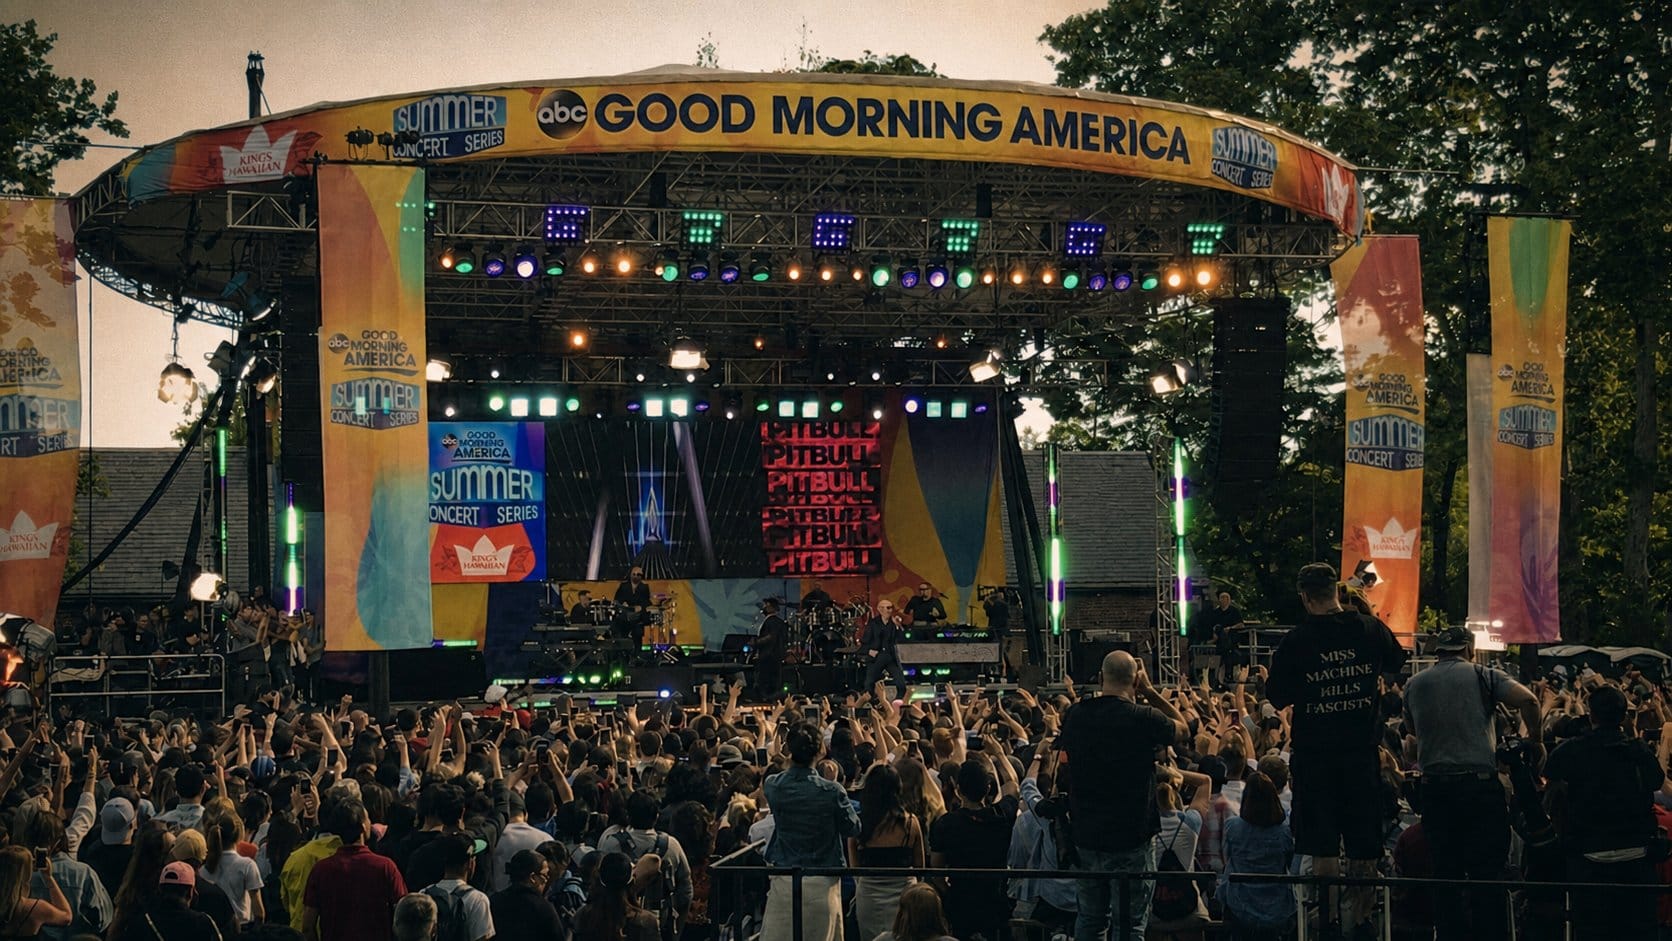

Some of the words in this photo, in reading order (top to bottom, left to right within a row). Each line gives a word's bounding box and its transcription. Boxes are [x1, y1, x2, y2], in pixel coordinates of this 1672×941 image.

[398, 95, 498, 132] SUMMER
[537, 101, 588, 124] abc
[595, 93, 755, 133] GOOD
[772, 95, 1003, 142] MORNING
[1009, 106, 1191, 165] AMERICA
[465, 130, 504, 153] SERIES
[1216, 128, 1275, 171] SUMMER
[1212, 159, 1246, 186] CONCERT
[328, 335, 350, 348] abc
[361, 330, 398, 340] GOOD
[350, 340, 408, 353] MORNING
[0, 356, 50, 368] ORNING
[343, 352, 416, 367] AMERICA
[0, 367, 62, 383] MERICA
[335, 379, 414, 409] SUMMER
[1511, 380, 1555, 396] AMERICA
[1366, 390, 1419, 407] AMERICA
[331, 409, 376, 428] CONCERT
[389, 411, 418, 427] SERIES
[1504, 405, 1552, 431] SUMMER
[467, 431, 496, 439] GOOD
[1353, 416, 1425, 452] SUMMER
[453, 447, 511, 458] AMERICA
[1347, 449, 1394, 469] CONCERT
[431, 465, 533, 500] SUMMER
[767, 471, 875, 493] PITBULL
[429, 506, 480, 525] ONCERT
[497, 505, 538, 524] SERIES
[767, 551, 877, 573] PITBULL
[1306, 663, 1373, 683] MACHINE
